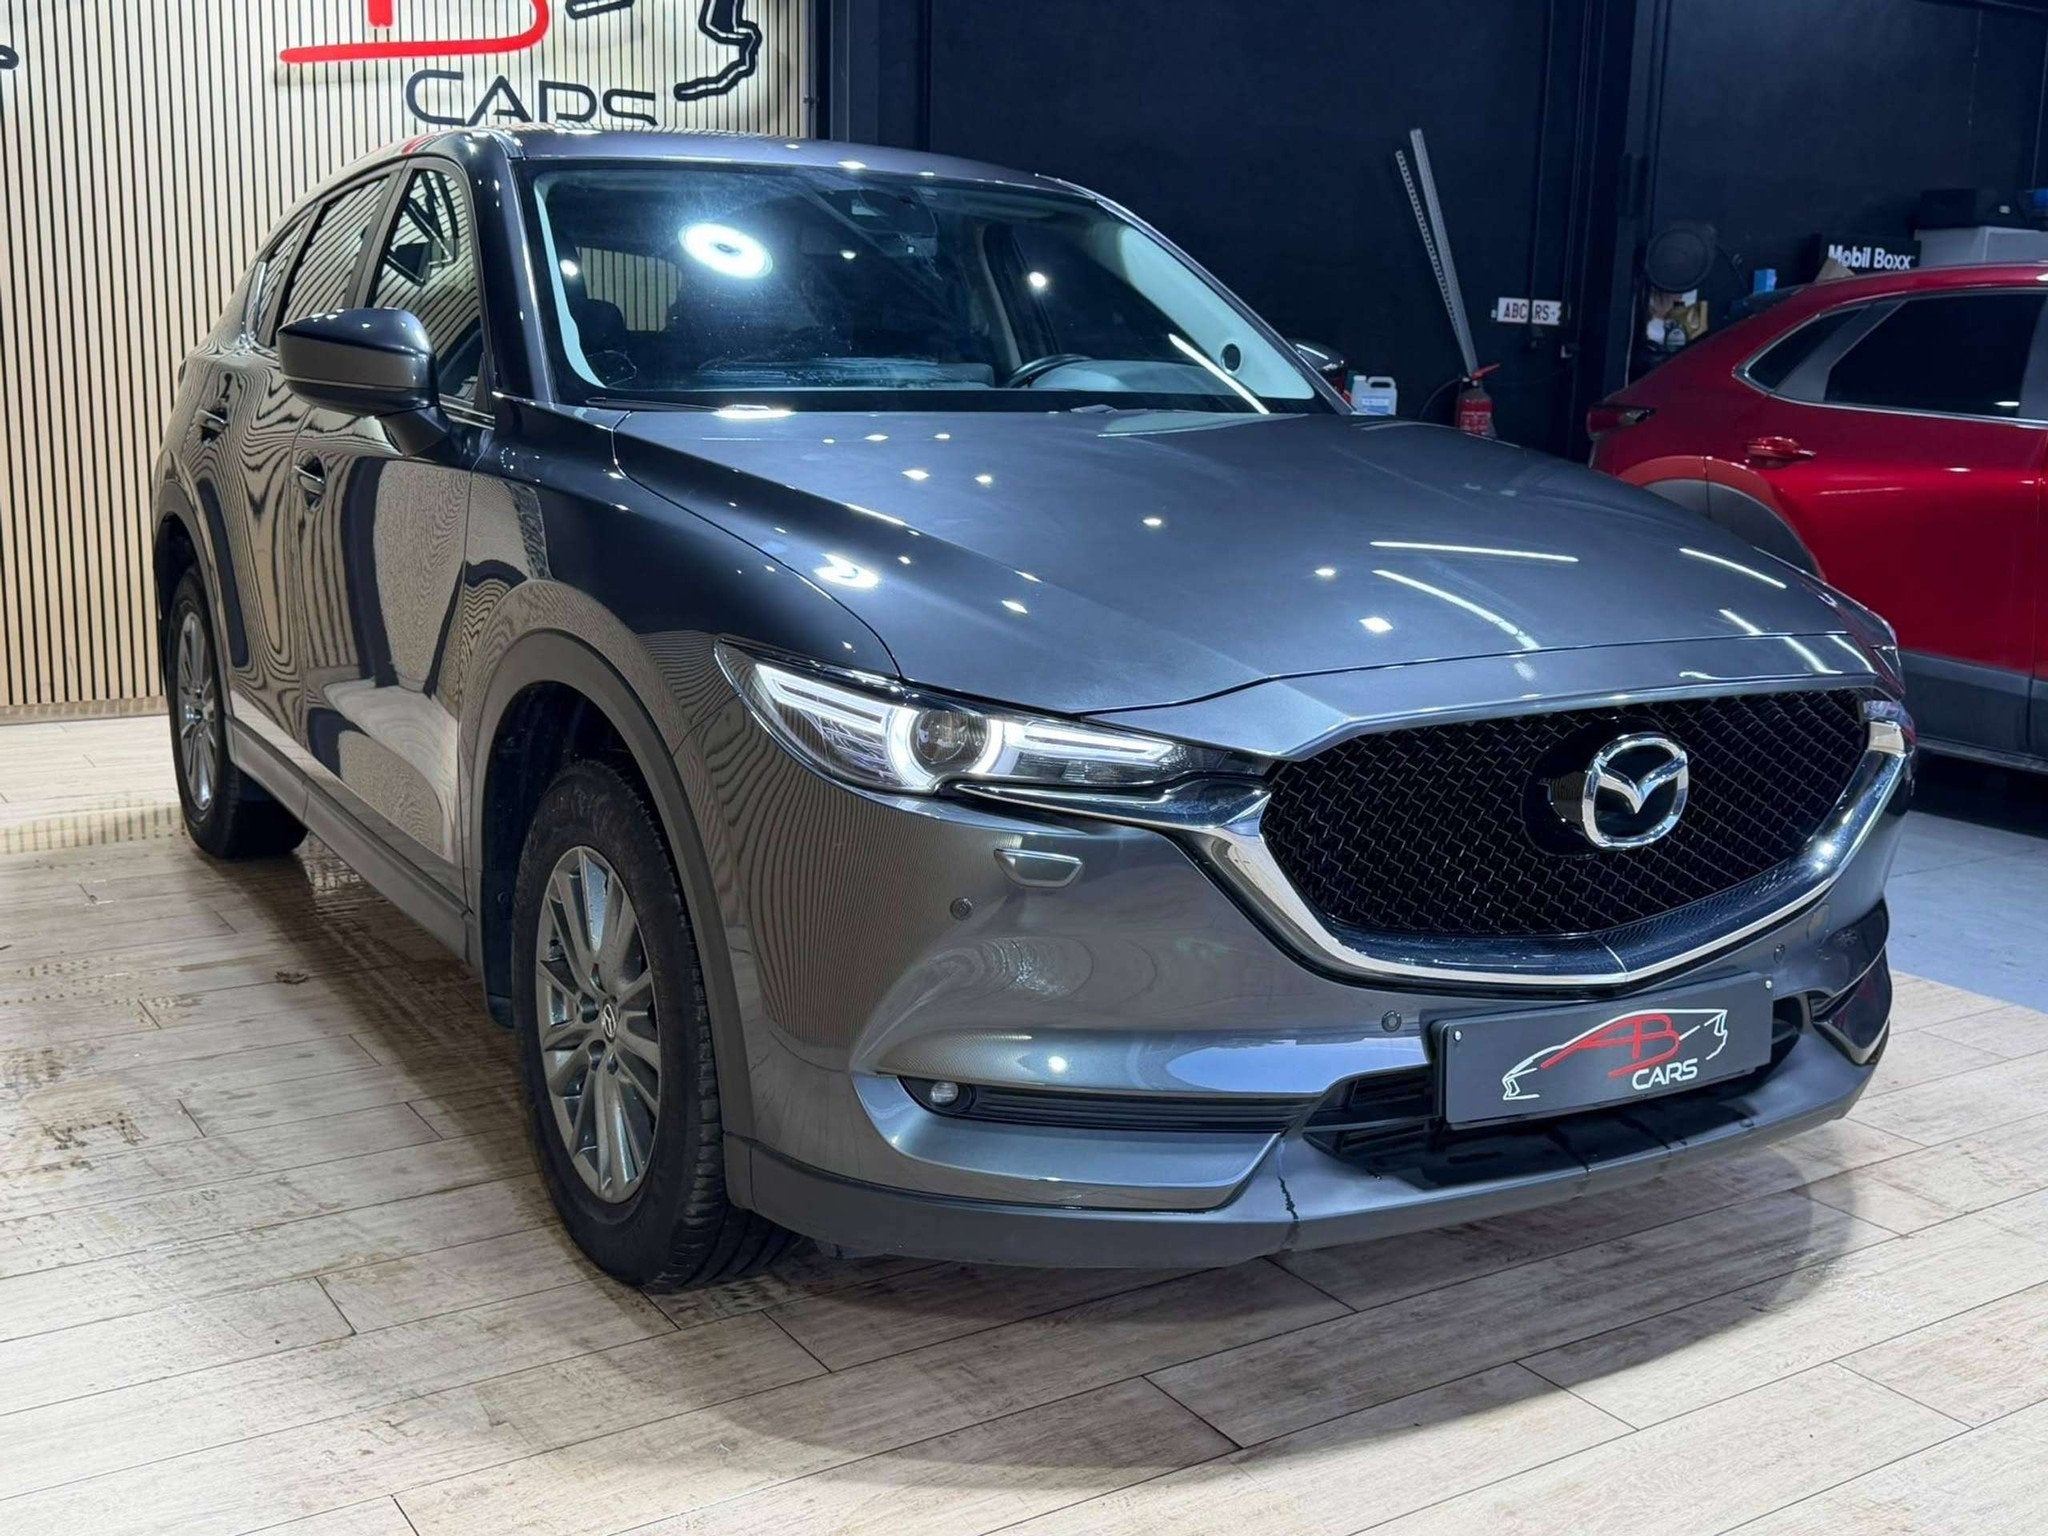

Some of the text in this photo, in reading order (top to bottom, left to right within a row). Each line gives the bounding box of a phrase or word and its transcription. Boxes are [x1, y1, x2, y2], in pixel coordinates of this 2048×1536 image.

[1828, 244, 1911, 270] Mobil Boxx
[1632, 1058, 1697, 1090] CARS
